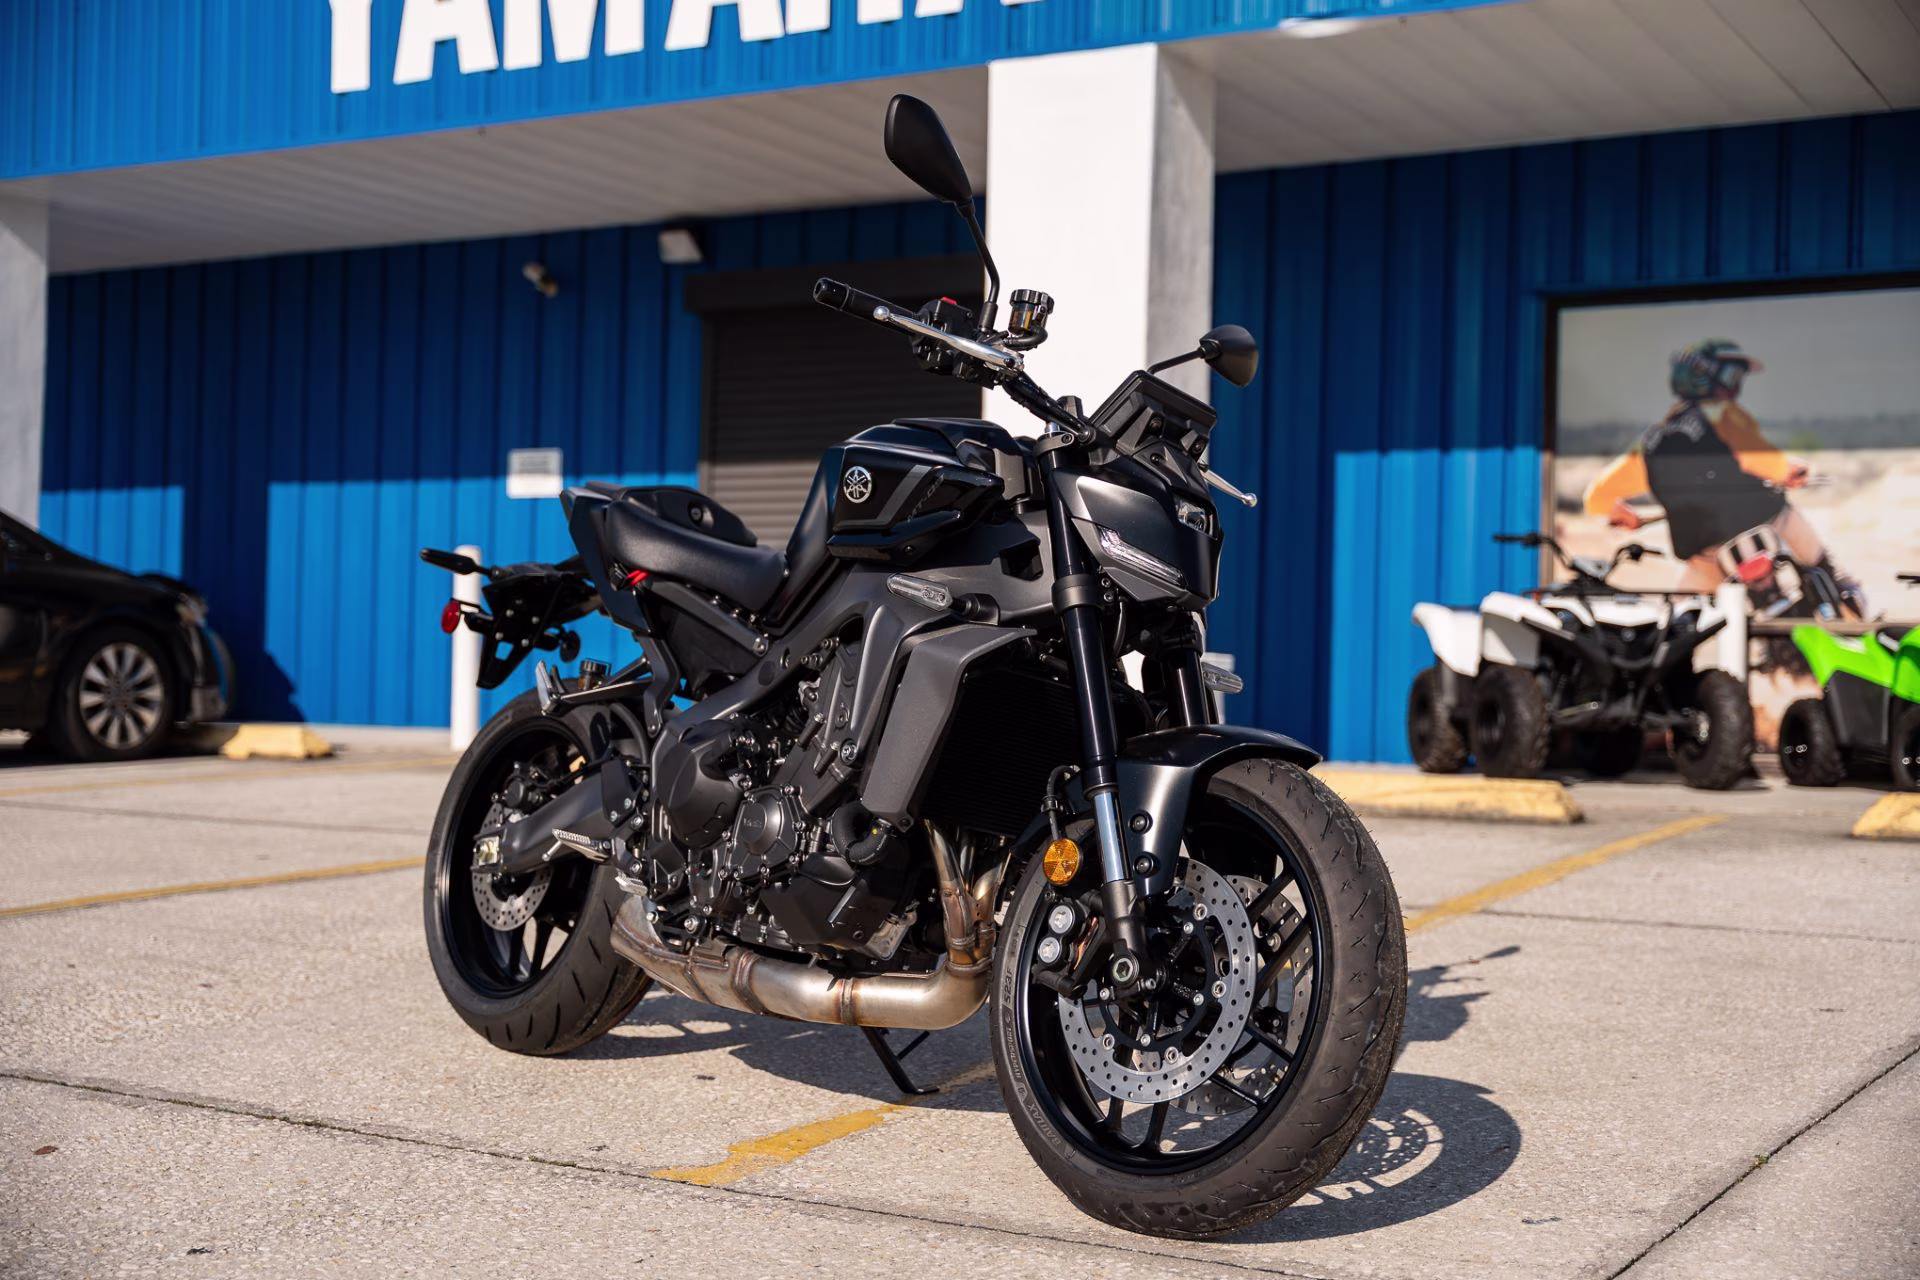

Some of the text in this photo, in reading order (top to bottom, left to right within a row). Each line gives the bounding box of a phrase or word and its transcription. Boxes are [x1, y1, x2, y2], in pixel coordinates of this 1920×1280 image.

[327, 0, 1047, 94] YAM
[1003, 969, 1014, 1003] S23F
[1028, 1103, 1062, 1146] BATTLAX
